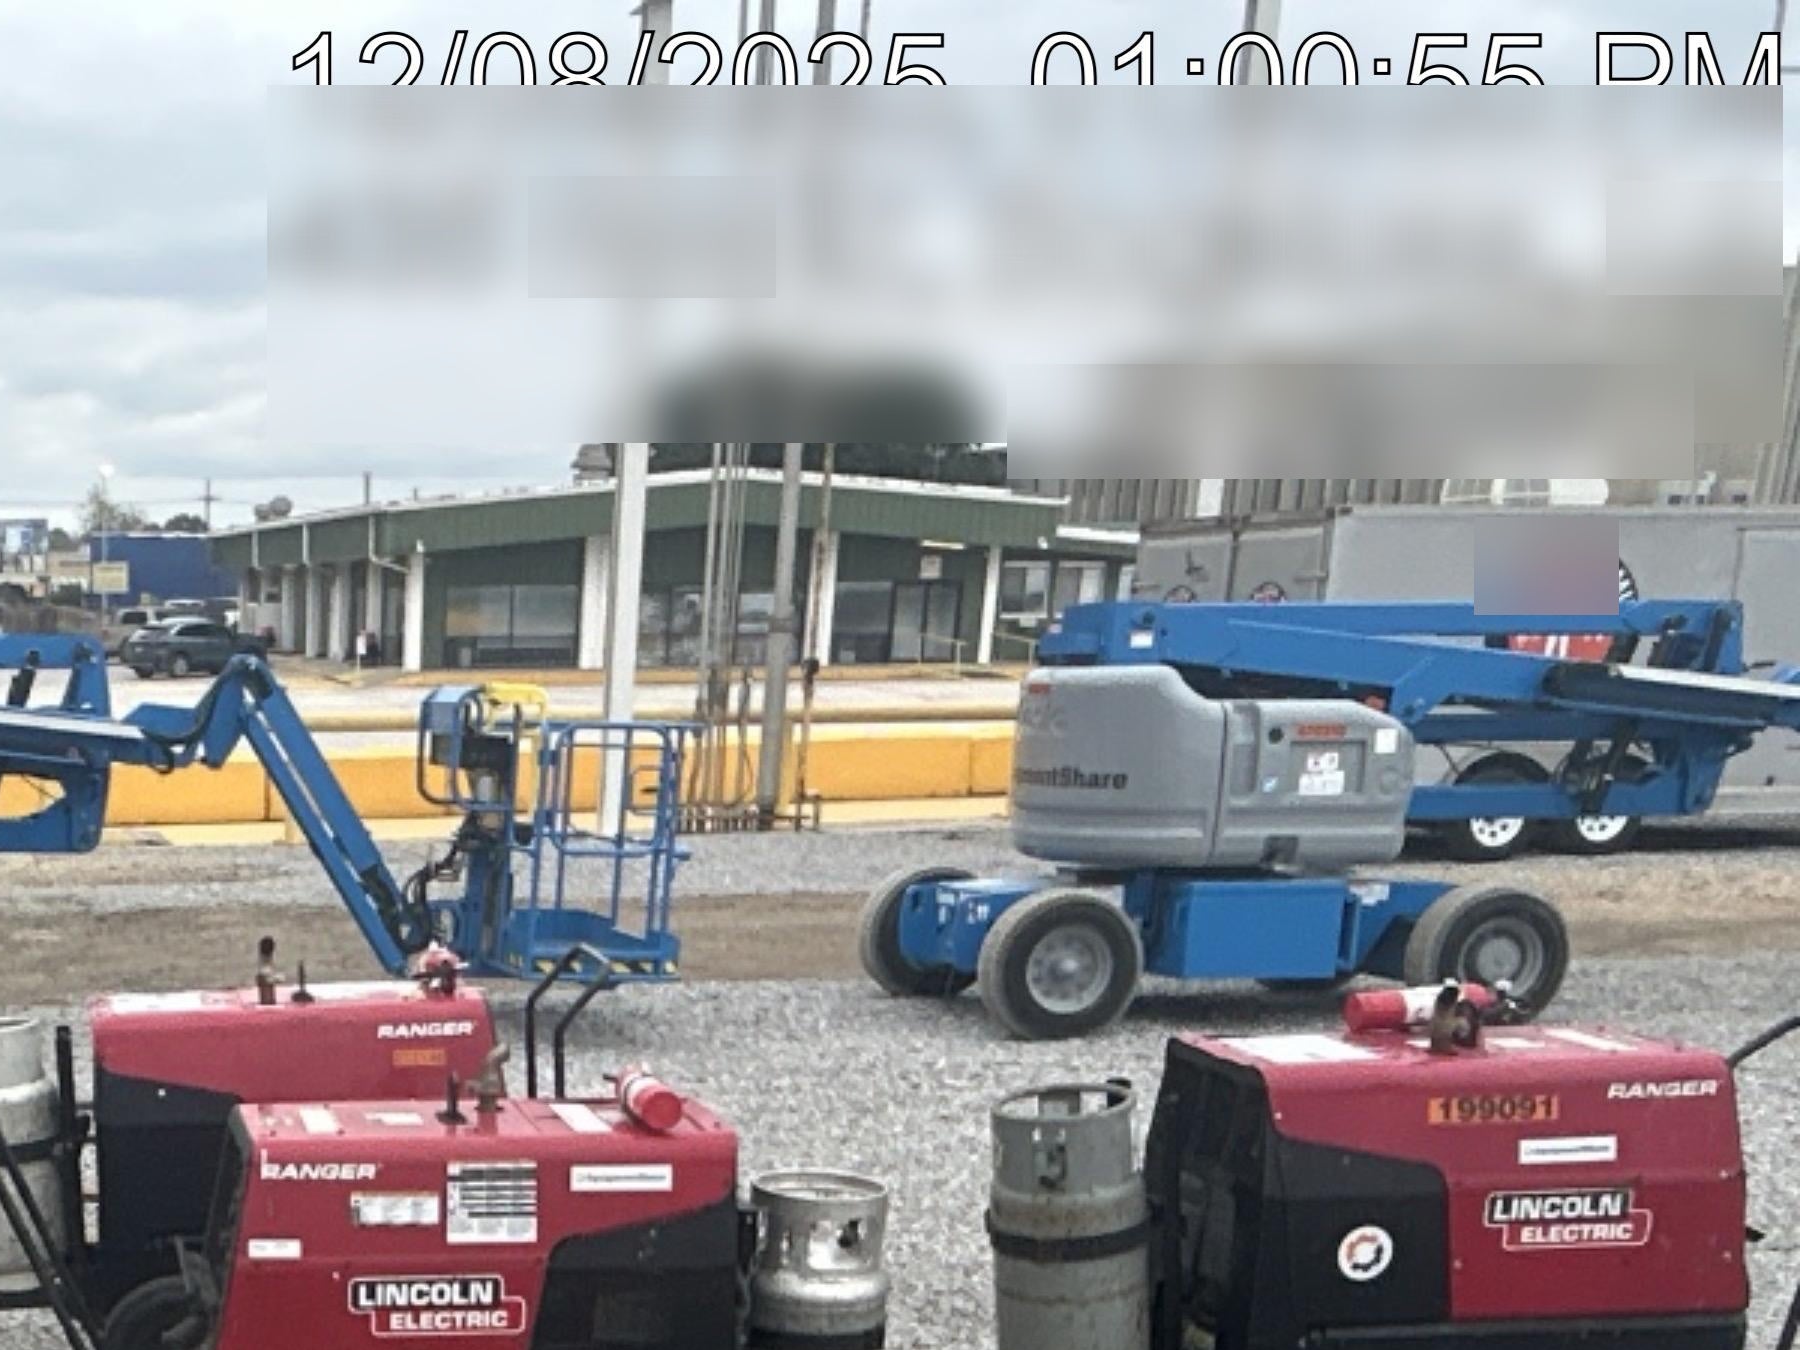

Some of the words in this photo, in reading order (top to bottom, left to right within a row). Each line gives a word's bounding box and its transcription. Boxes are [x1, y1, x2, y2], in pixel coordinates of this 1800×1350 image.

[376, 1021, 474, 1039] RANGER
[1606, 1079, 1719, 1099] RANGER
[1439, 1095, 1553, 1121] 199091
[260, 1162, 377, 1180] RANGER
[1493, 1193, 1624, 1221] LINCOLN
[1519, 1223, 1634, 1244] ELECTRIC
[358, 1280, 494, 1307] LINCOLN
[388, 1310, 509, 1330] ELECTRIC
